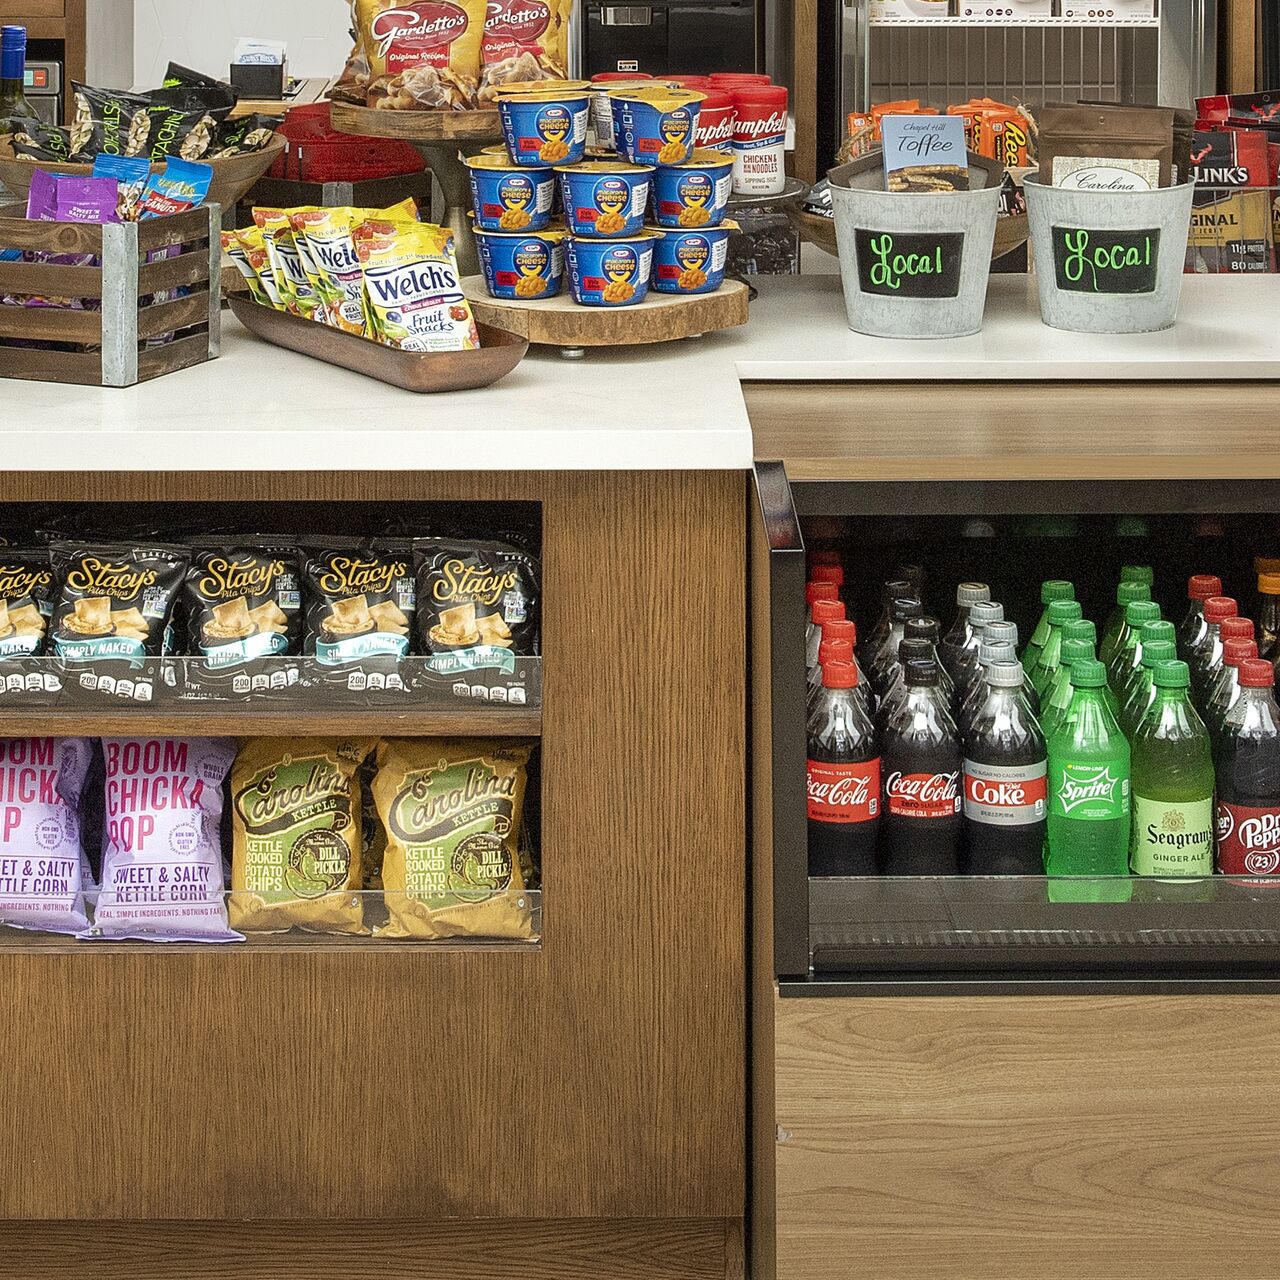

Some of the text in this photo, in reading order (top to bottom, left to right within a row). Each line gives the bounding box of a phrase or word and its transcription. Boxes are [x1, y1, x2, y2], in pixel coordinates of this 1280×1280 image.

[370, 9, 466, 59] Gardetto's
[389, 51, 420, 63] Original
[903, 123, 946, 133] Chapel Hill
[898, 133, 953, 157] Toffee
[743, 154, 772, 164] CHICKEN
[751, 163, 778, 174] NOODLES
[1194, 166, 1249, 185] LINK'S
[1074, 169, 1136, 192] Carolina
[870, 233, 943, 290] Local
[1065, 229, 1151, 292] Local
[1231, 261, 1247, 270] 80
[371, 264, 457, 304] Welch's
[412, 310, 443, 329] Fruit
[407, 321, 454, 335] Snacks
[67, 557, 158, 600] Stacy's
[106, 587, 129, 597] Chips
[97, 642, 134, 656] NAKED
[80, 676, 96, 685] 200
[106, 740, 189, 777] BOOM
[203, 763, 226, 772] WHOLE
[1072, 764, 1104, 772] LEMON-LIME
[886, 770, 960, 803] Coca-Cola
[971, 780, 1026, 806] Coke
[1005, 782, 1022, 791] Diet
[1062, 778, 1113, 801] Sprite
[107, 775, 205, 817] CHICKA
[901, 799, 920, 808] zero
[1146, 822, 1213, 850] Seagram's
[246, 853, 283, 865] COOKED
[318, 846, 341, 861] DILL
[1152, 853, 1205, 863] GINGER ALE
[1253, 855, 1269, 867] 23
[22, 862, 33, 876] &
[37, 861, 75, 878] SALTY
[245, 865, 283, 878] POTATO
[313, 860, 347, 875] PICKLE
[33, 878, 69, 894] CORN
[245, 877, 283, 892] CHIPS
[116, 908, 208, 918] SIMPLE NOTHING
